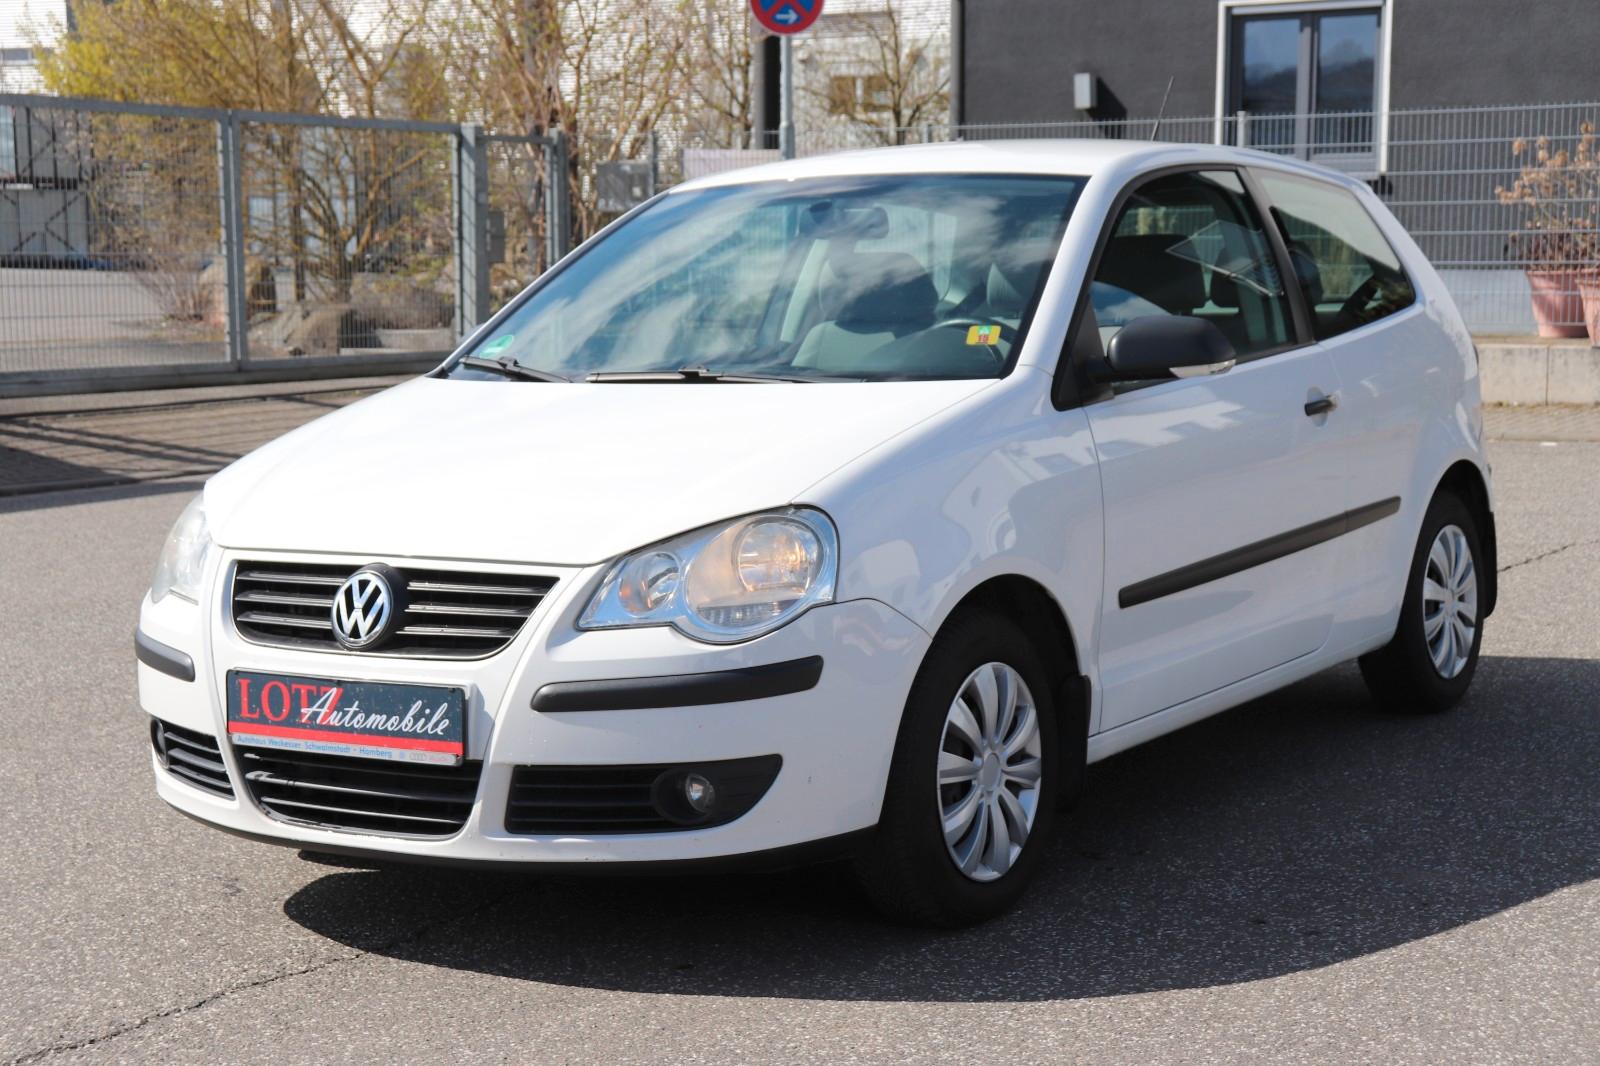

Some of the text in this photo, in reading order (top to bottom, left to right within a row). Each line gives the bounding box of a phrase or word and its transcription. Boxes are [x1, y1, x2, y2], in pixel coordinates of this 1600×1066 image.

[335, 573, 389, 645] VW
[238, 678, 450, 735] LOTZ Automobile
[359, 746, 393, 759] Homberg
